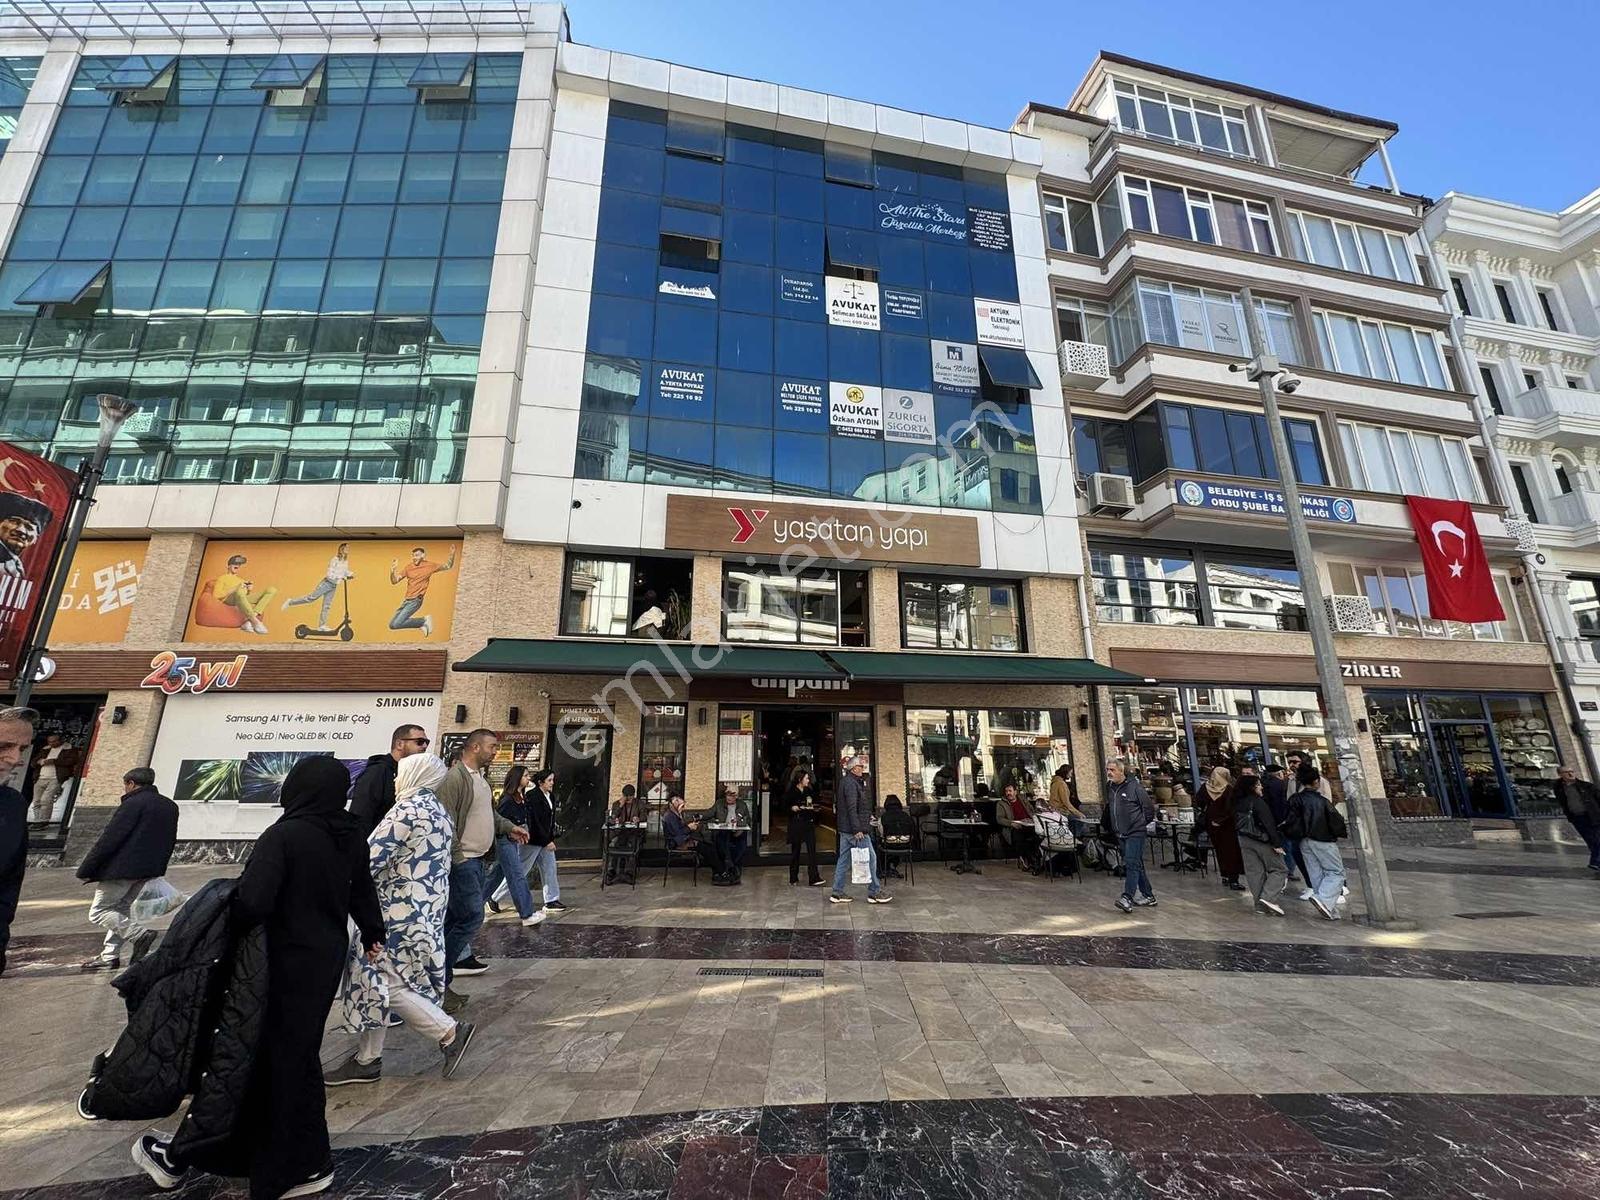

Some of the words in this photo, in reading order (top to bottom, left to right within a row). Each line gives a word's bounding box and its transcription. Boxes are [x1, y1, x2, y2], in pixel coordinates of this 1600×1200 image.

[908, 205, 931, 219] The
[932, 206, 966, 225] Stars
[925, 223, 967, 240] Merkezi
[832, 299, 877, 312] AVUKAT
[990, 307, 1009, 316] AKTÜRK
[832, 309, 856, 318] Selimcan
[661, 368, 704, 382] AVUKAT
[781, 382, 821, 396] AVUKAT
[832, 403, 879, 417] AVUKAT
[832, 415, 855, 424] Özkan
[857, 417, 879, 426] AYDIN
[887, 411, 926, 423] ZURICH
[887, 421, 930, 434] SİGORTA
[1208, 486, 1257, 500] BELEDİYE
[1264, 491, 1274, 502] İŞ
[1277, 494, 1328, 508] SİKASI
[1211, 498, 1239, 509] ORDU
[1242, 502, 1269, 512] ŞUBE
[1271, 503, 1329, 518] BANLIĞI
[773, 518, 872, 542] yaşatan
[880, 526, 928, 550] yapı
[1341, 661, 1402, 679] ZİRLER
[376, 698, 434, 708] SAMSUNG
[225, 714, 268, 724] Samsung
[270, 714, 279, 722] AI
[281, 714, 293, 722] TV
[318, 714, 335, 722] Yeni
[337, 714, 349, 722] Bir
[351, 714, 371, 725] Çağ
[572, 715, 599, 723] MERKEZİ
[236, 732, 252, 740] Neo
[253, 732, 275, 741] QLED
[278, 732, 295, 740] Neo
[296, 732, 317, 741] QLED
[332, 732, 353, 740] OLED
